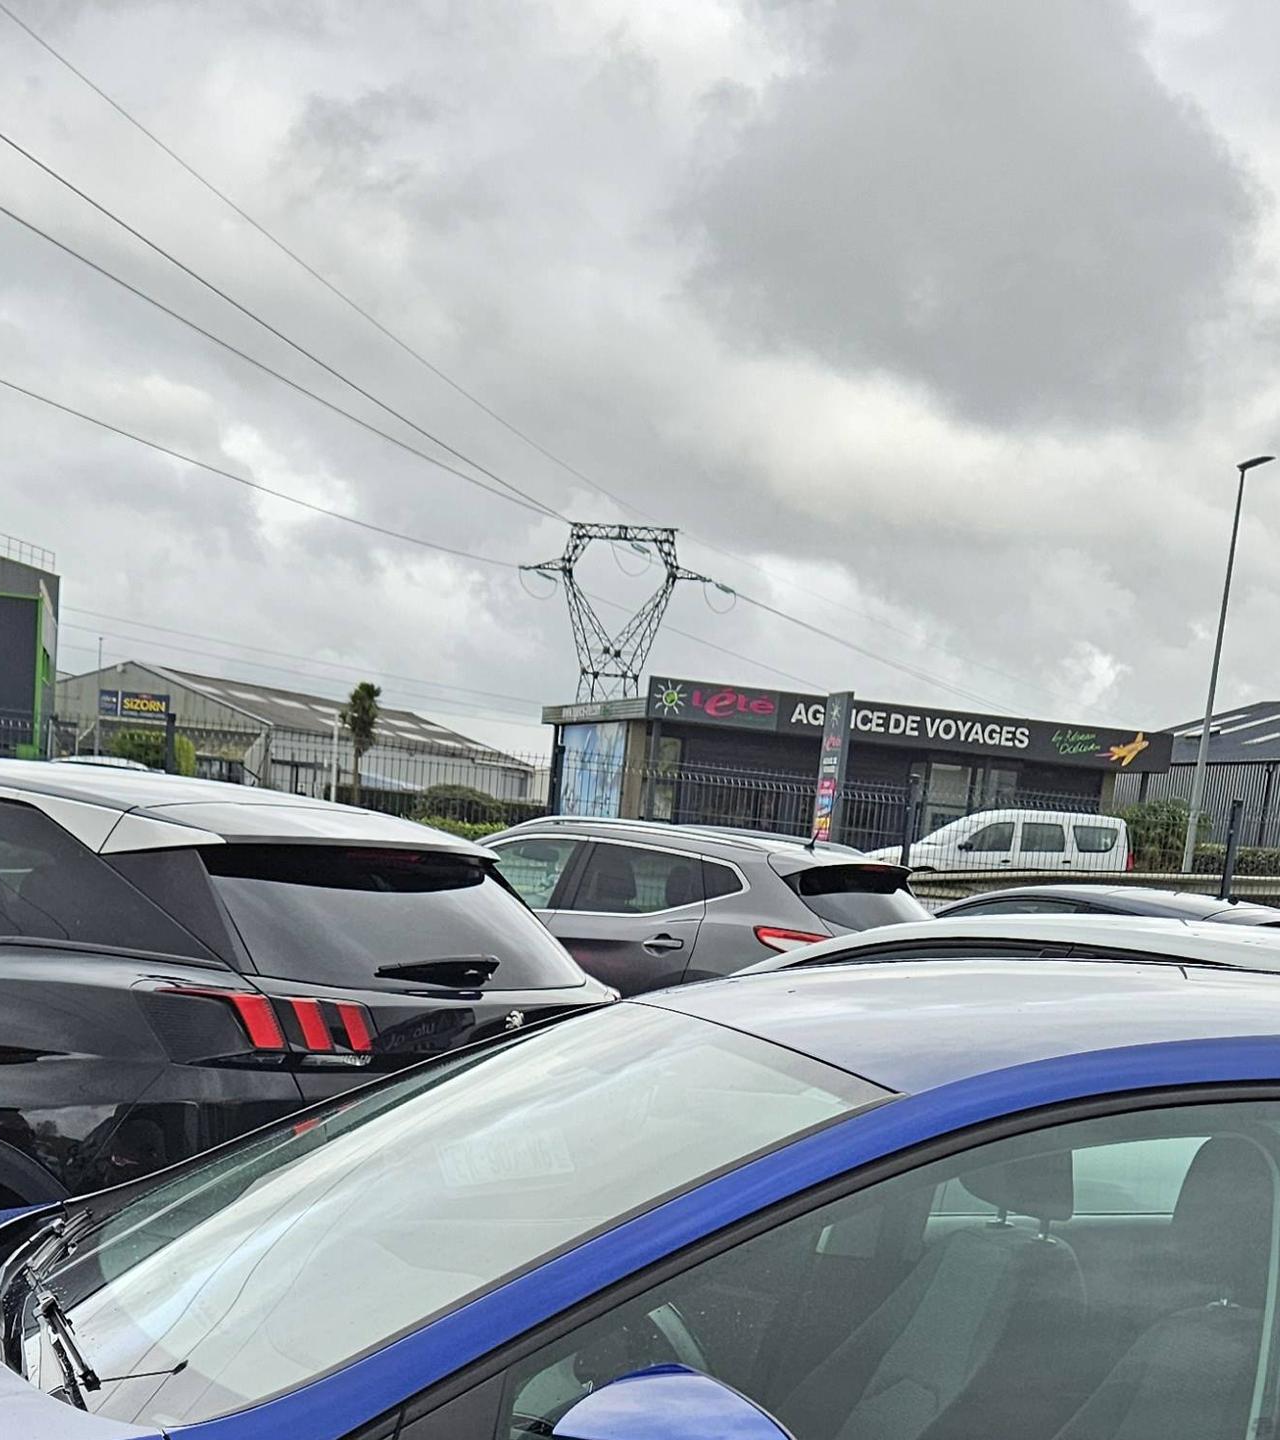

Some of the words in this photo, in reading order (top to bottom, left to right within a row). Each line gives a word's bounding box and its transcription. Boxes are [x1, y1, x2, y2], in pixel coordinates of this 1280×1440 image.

[791, 702, 885, 733] AGCE
[888, 711, 920, 737] DE
[925, 716, 1030, 749] VOYAGES
